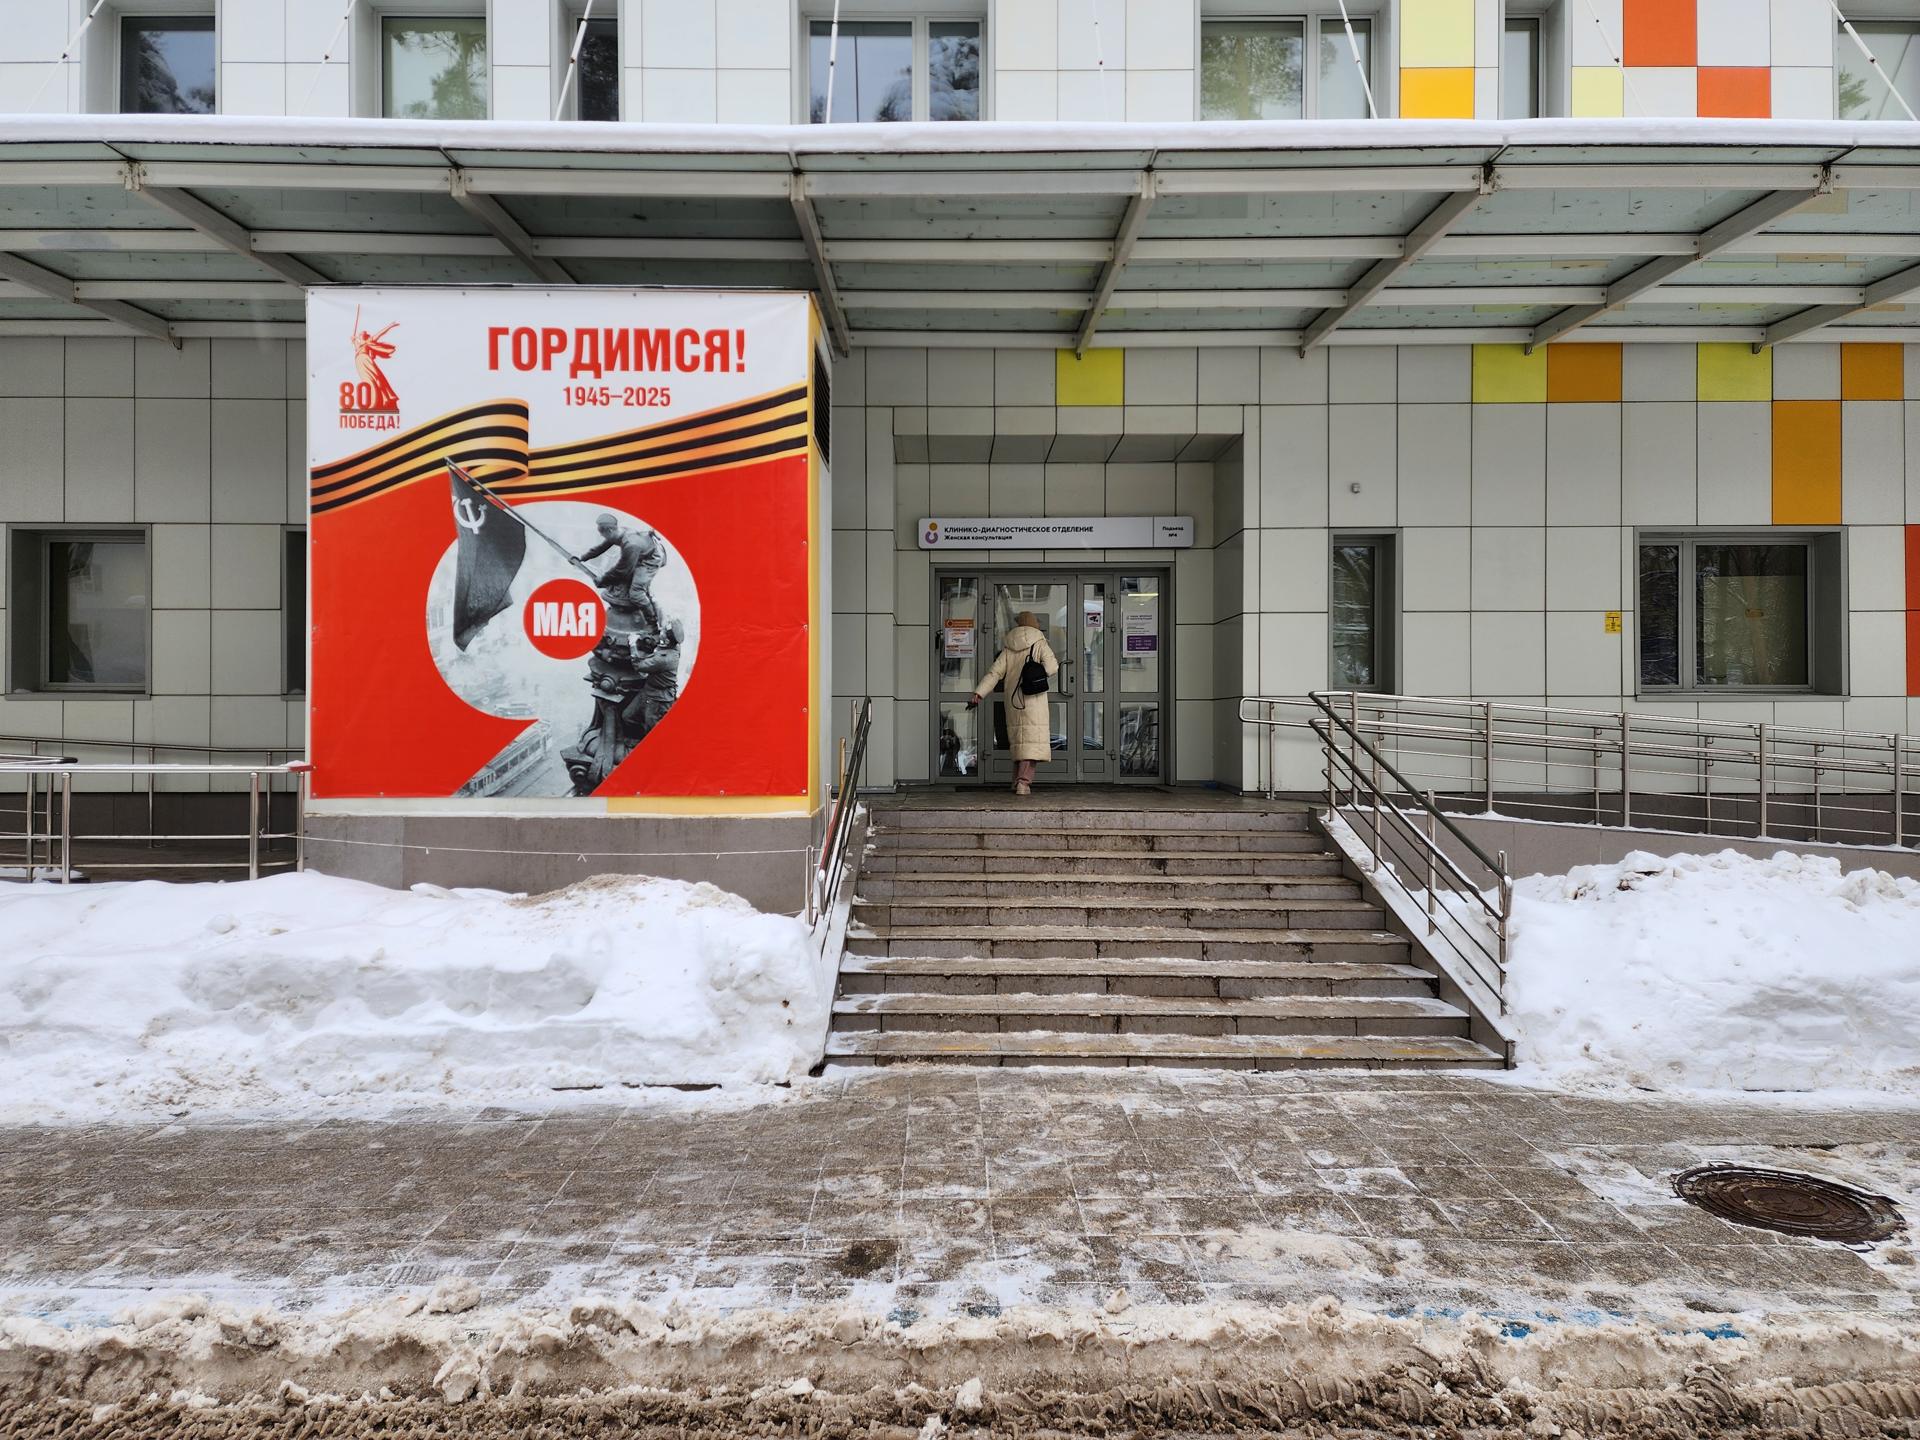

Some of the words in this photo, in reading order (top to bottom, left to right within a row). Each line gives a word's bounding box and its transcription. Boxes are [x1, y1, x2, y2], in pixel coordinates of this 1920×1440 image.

[488, 327, 745, 378] ГОРДИМСЯ!
[563, 386, 671, 407] 1945–2025
[339, 414, 400, 431] ПОБЕДА!
[533, 602, 596, 637] МАЯ
